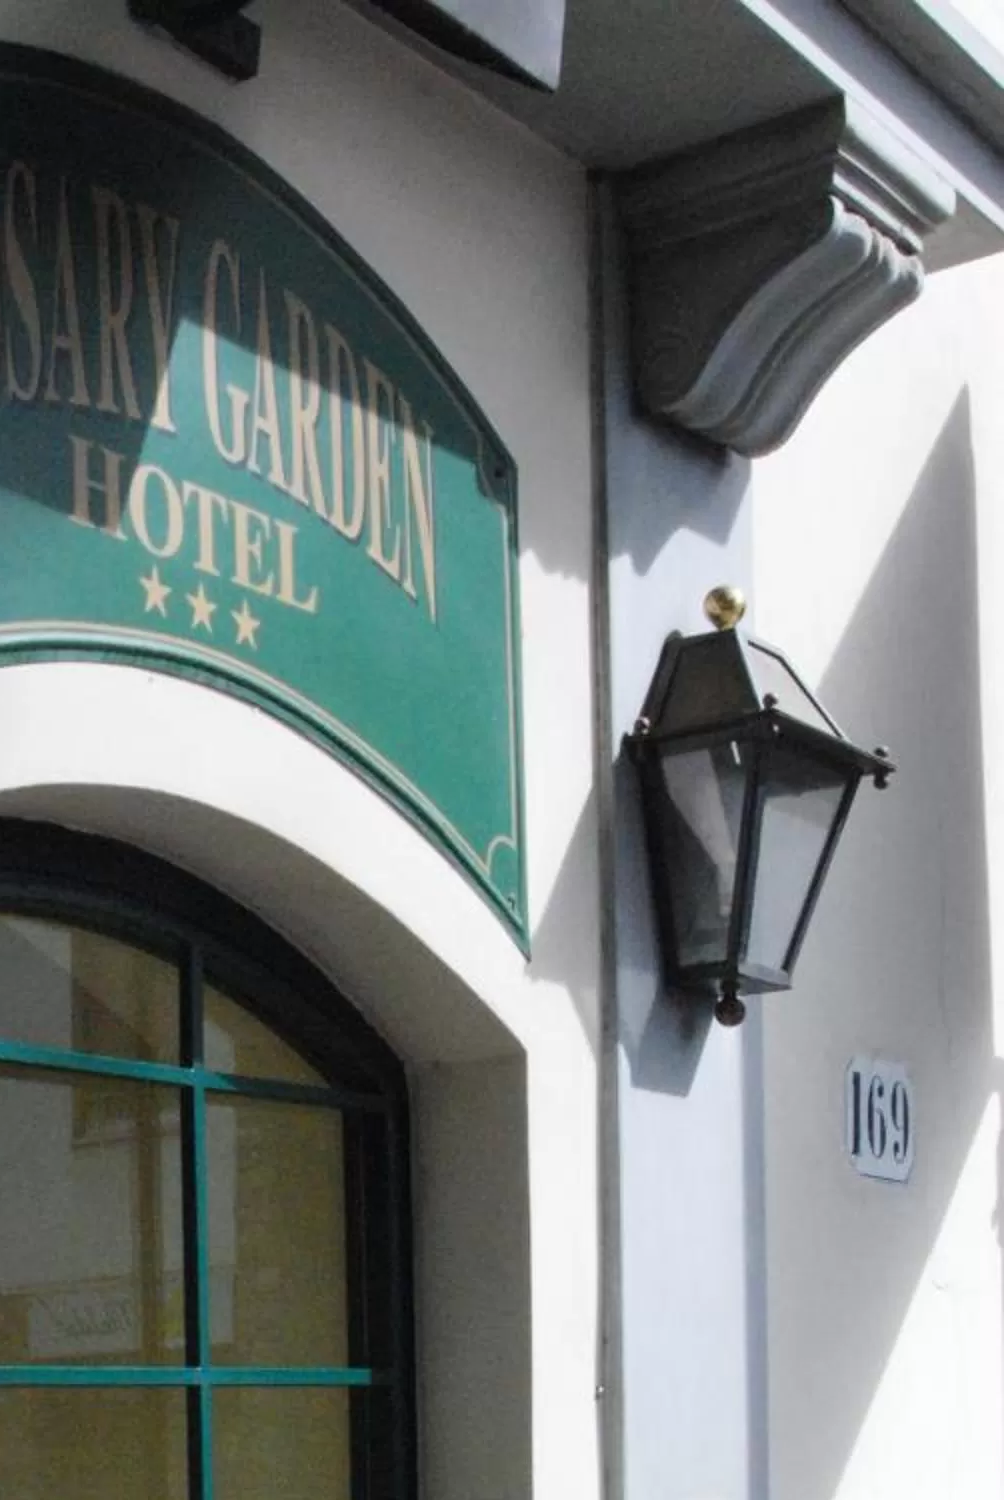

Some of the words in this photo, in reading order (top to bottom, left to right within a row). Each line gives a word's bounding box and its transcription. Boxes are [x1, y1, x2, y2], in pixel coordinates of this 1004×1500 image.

[202, 238, 438, 627] GARDEN
[68, 434, 318, 614] HOTEL
[851, 1071, 909, 1164] 169
